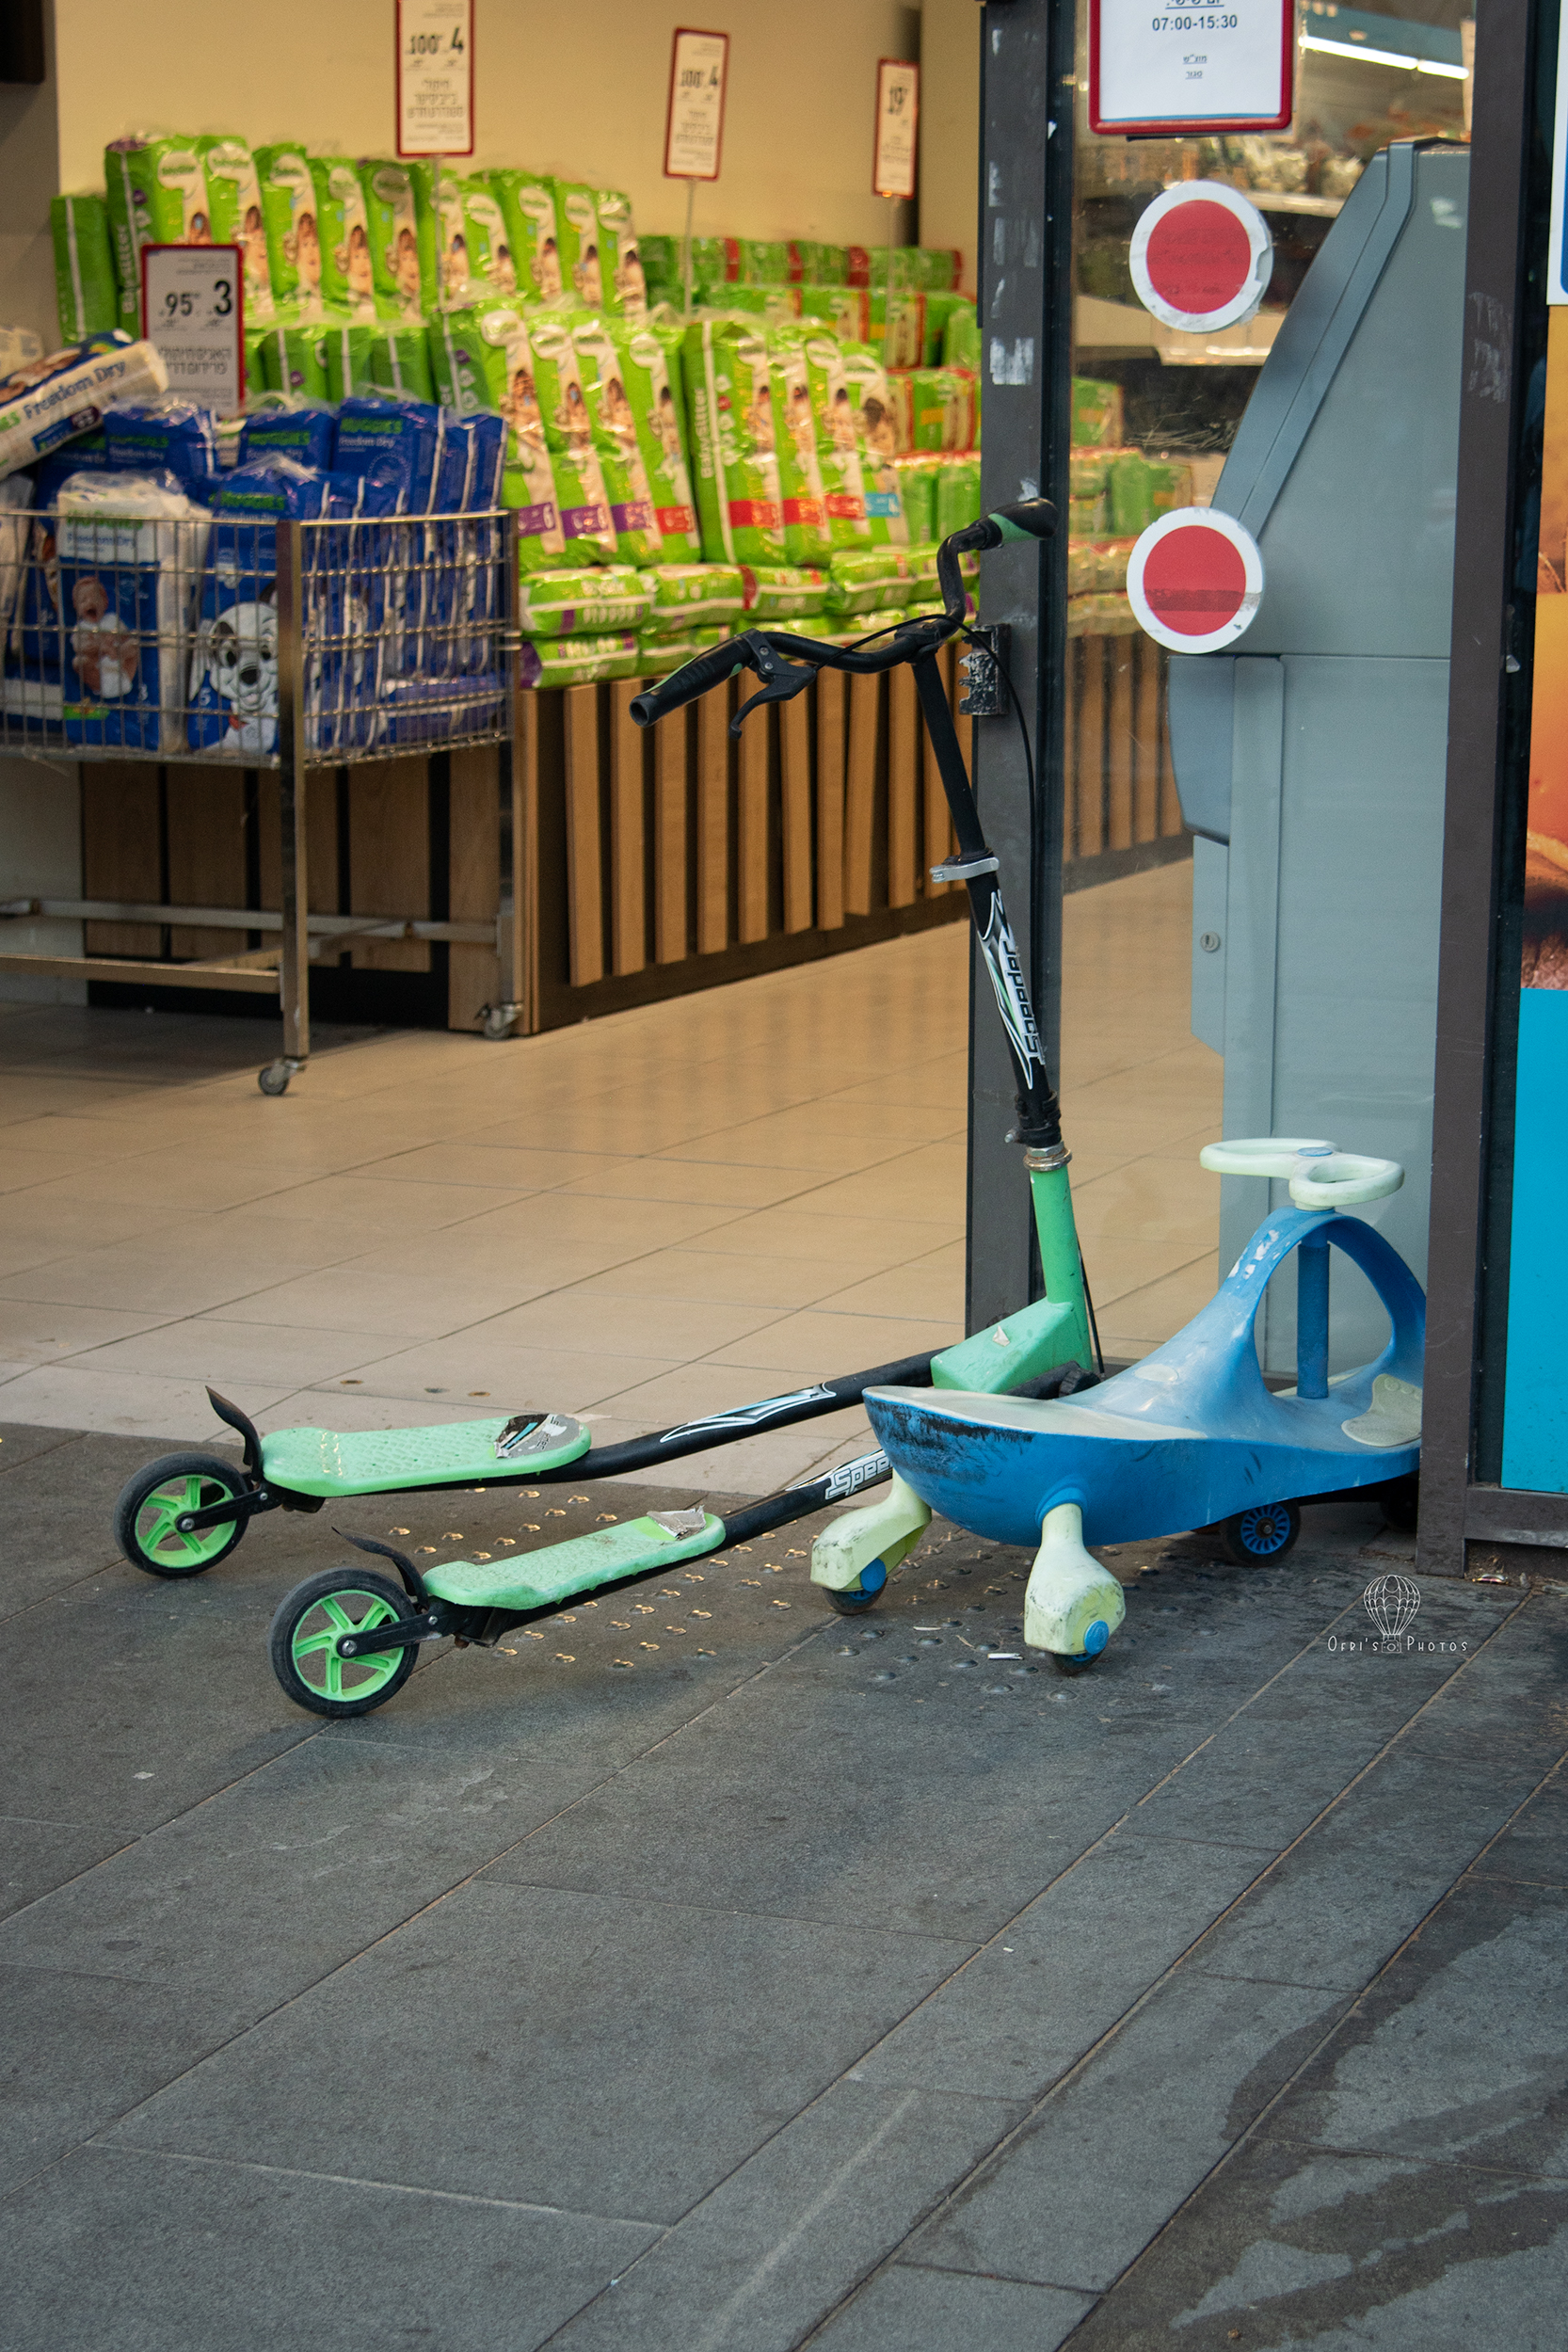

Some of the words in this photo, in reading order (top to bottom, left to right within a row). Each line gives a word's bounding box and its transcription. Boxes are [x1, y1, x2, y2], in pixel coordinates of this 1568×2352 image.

[1151, 14, 1239, 31] 07:00-15:30
[449, 26, 464, 55] 4
[1185, 71, 1203, 79] סגור
[165, 293, 193, 317] 95
[214, 279, 232, 317] 3
[24, 376, 94, 419] Freedom
[94, 361, 126, 382] Dry
[825, 1455, 892, 1499] Spee
